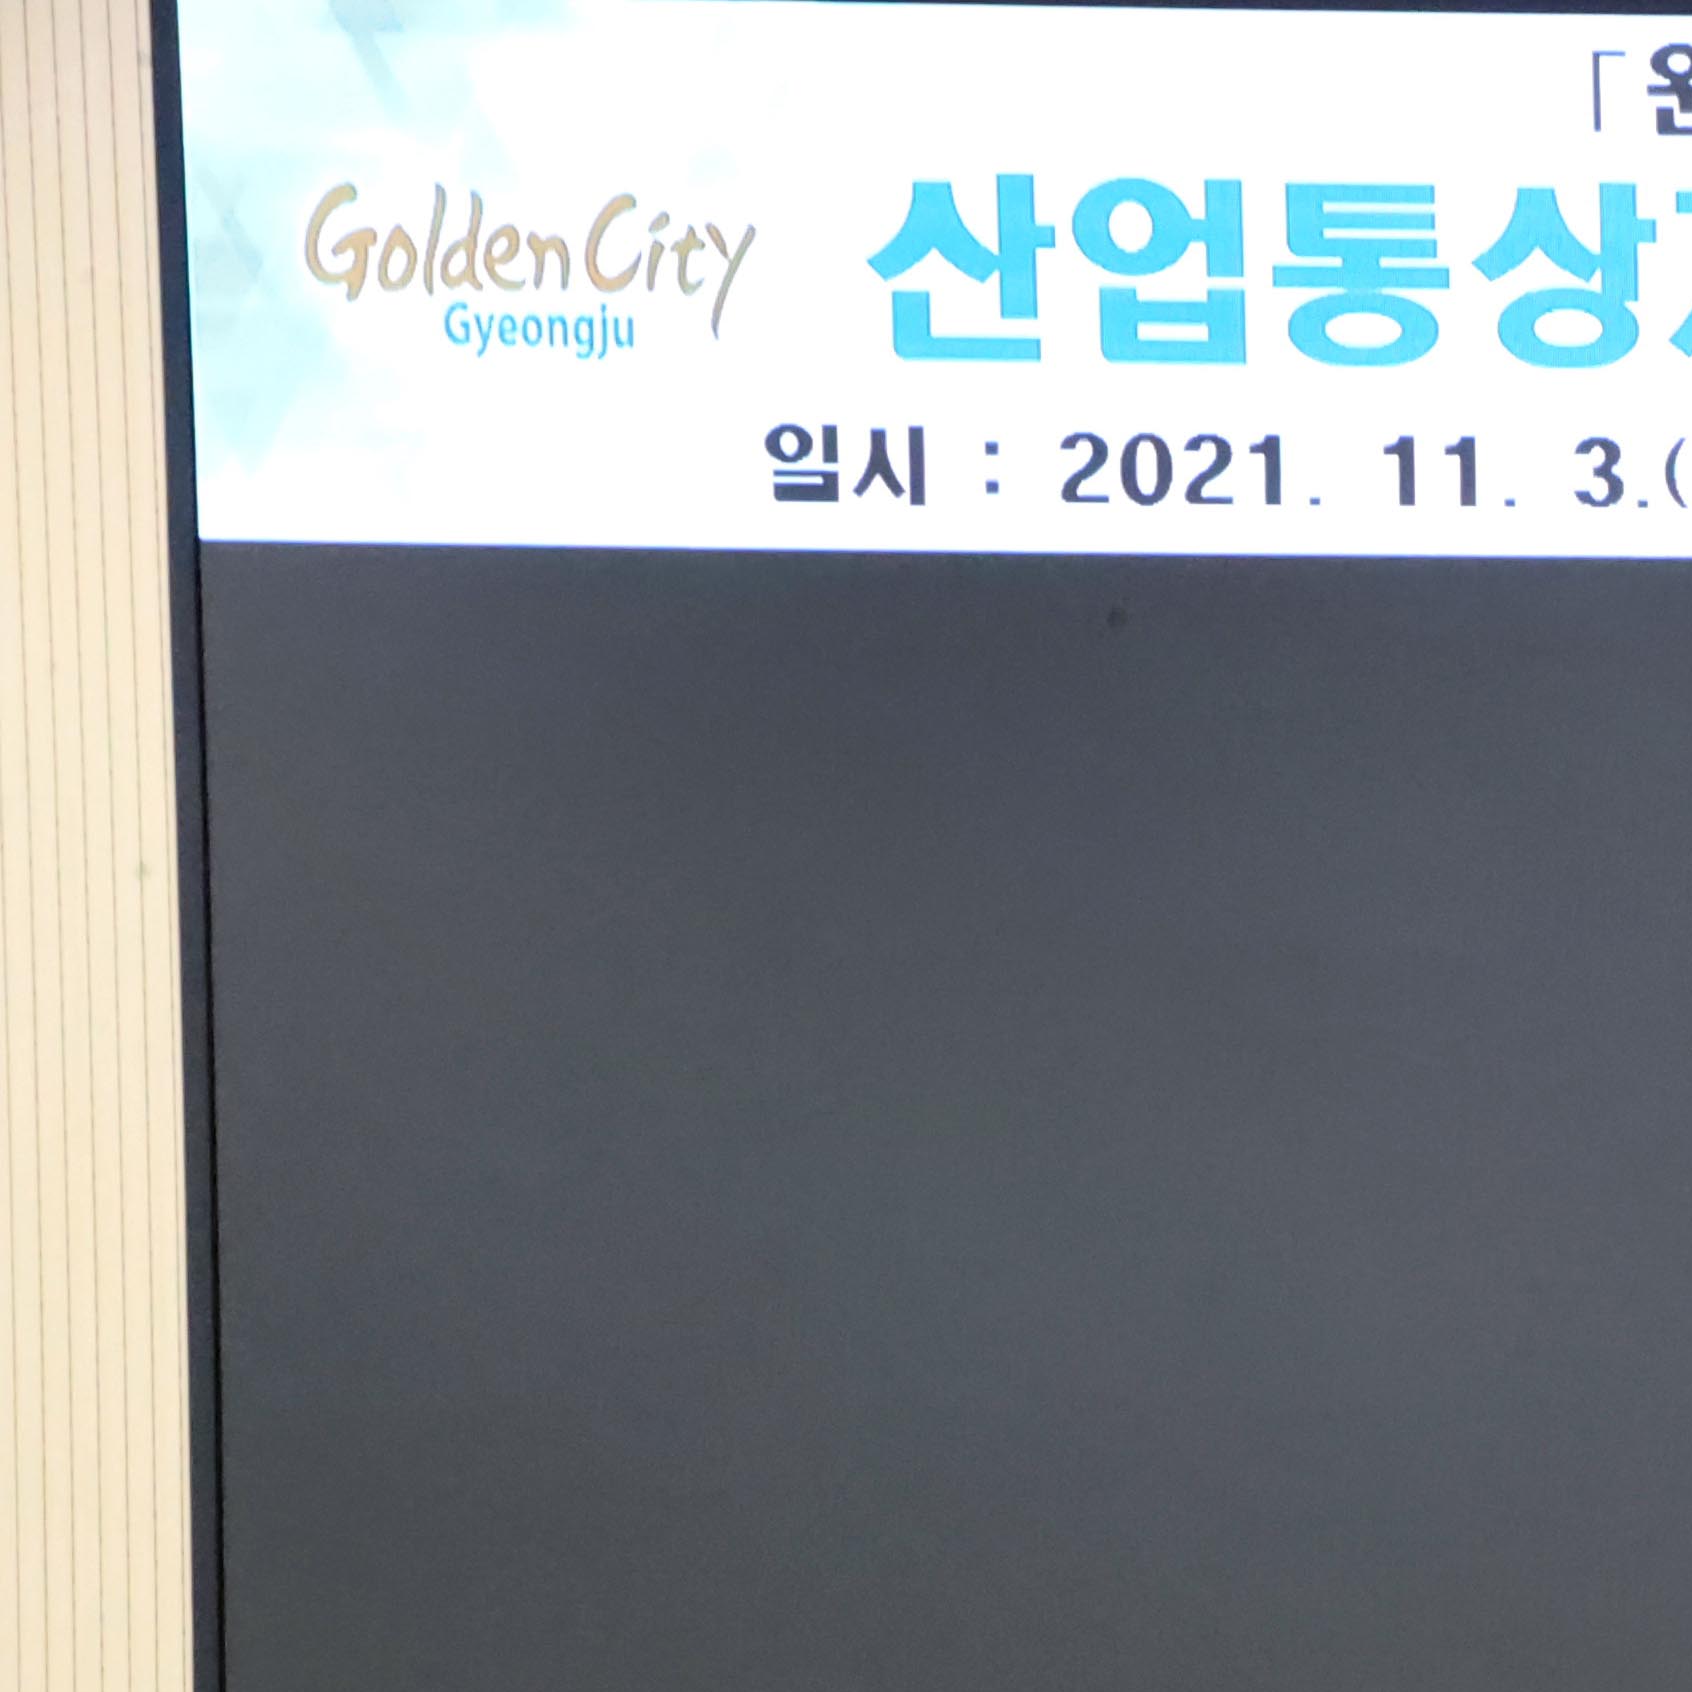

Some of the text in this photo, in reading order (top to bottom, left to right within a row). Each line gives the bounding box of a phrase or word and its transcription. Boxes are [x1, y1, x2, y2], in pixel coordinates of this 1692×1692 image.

[304, 182, 756, 340] Golden City
[444, 300, 635, 360] Gyeongju
[764, 423, 926, 506] 일시
[1060, 431, 1321, 507] 2021.
[1383, 435, 1516, 507] 11.
